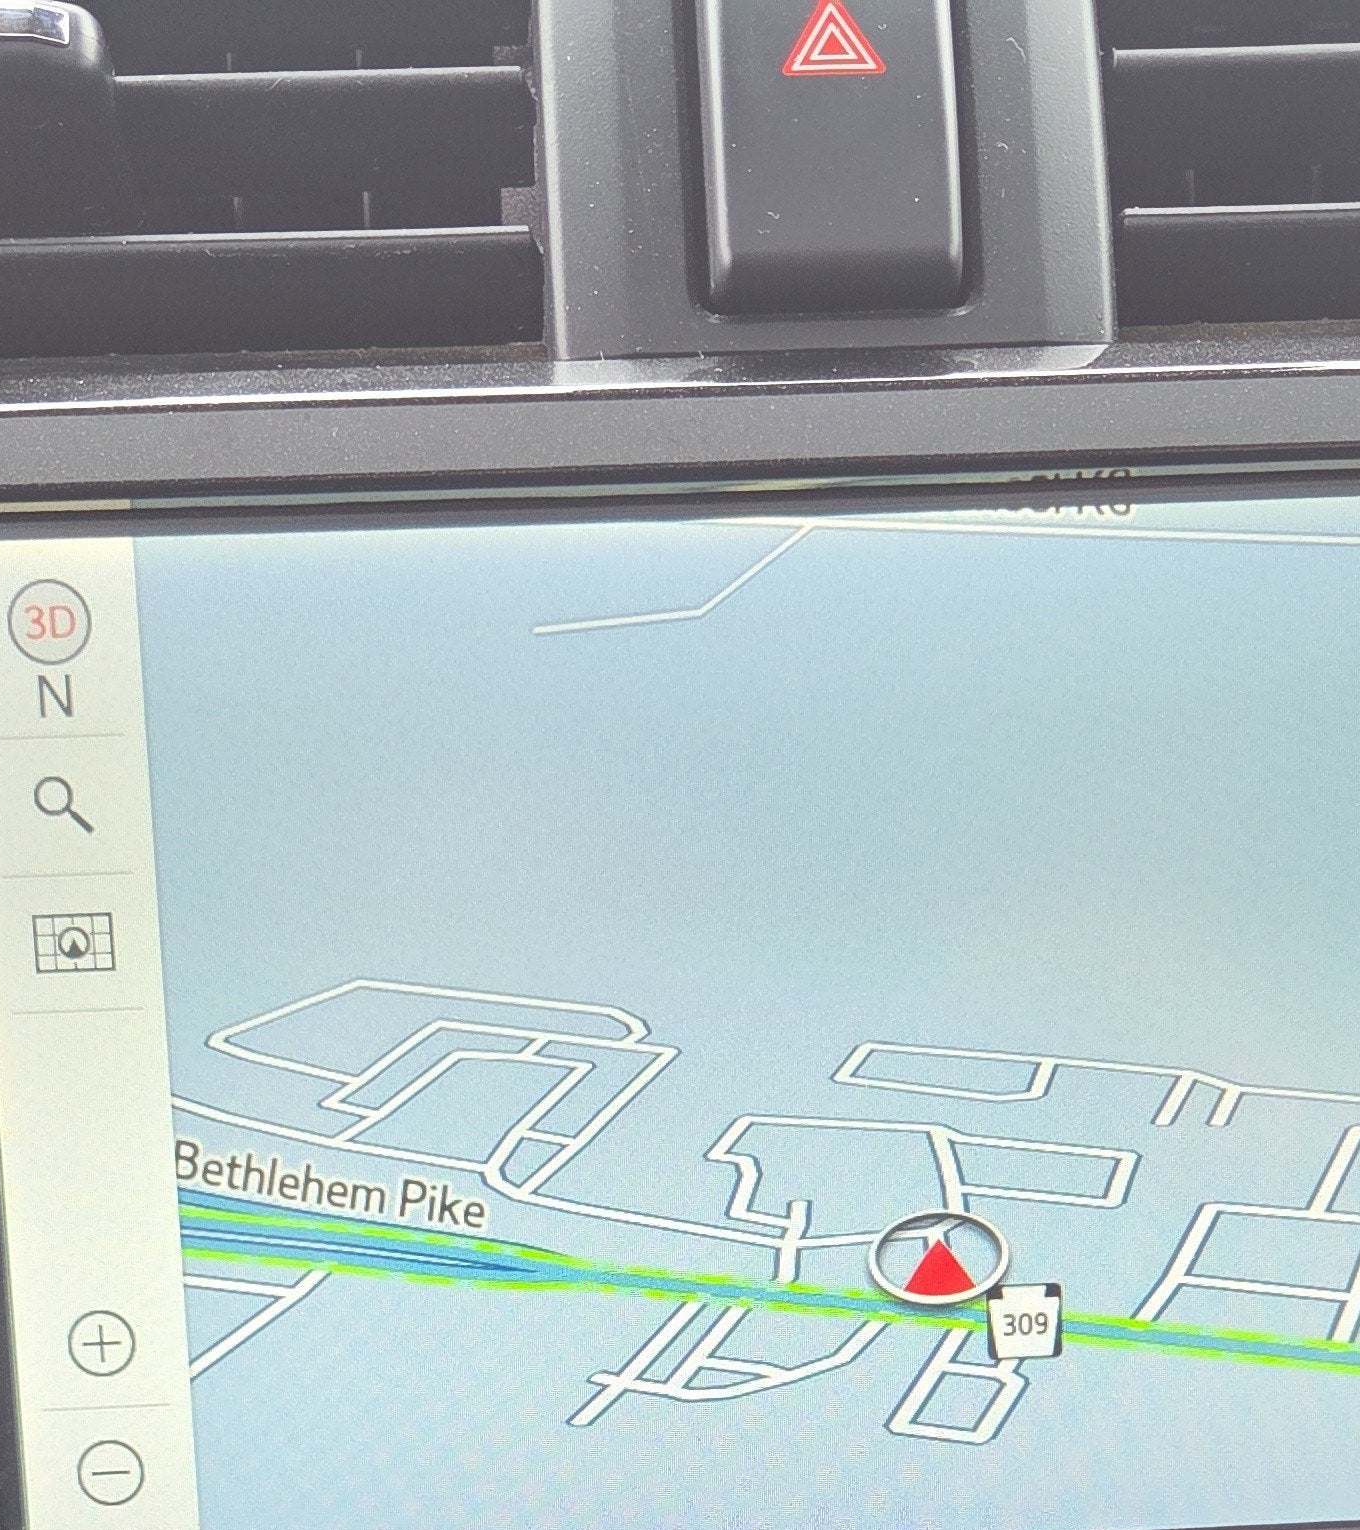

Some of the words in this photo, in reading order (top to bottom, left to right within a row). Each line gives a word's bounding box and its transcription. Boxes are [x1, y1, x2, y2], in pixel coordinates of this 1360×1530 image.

[23, 604, 77, 640] 3D
[37, 674, 74, 718] N
[175, 1139, 387, 1216] Bethlehem
[398, 1177, 487, 1229] Pike
[1002, 1311, 1049, 1337] 309
